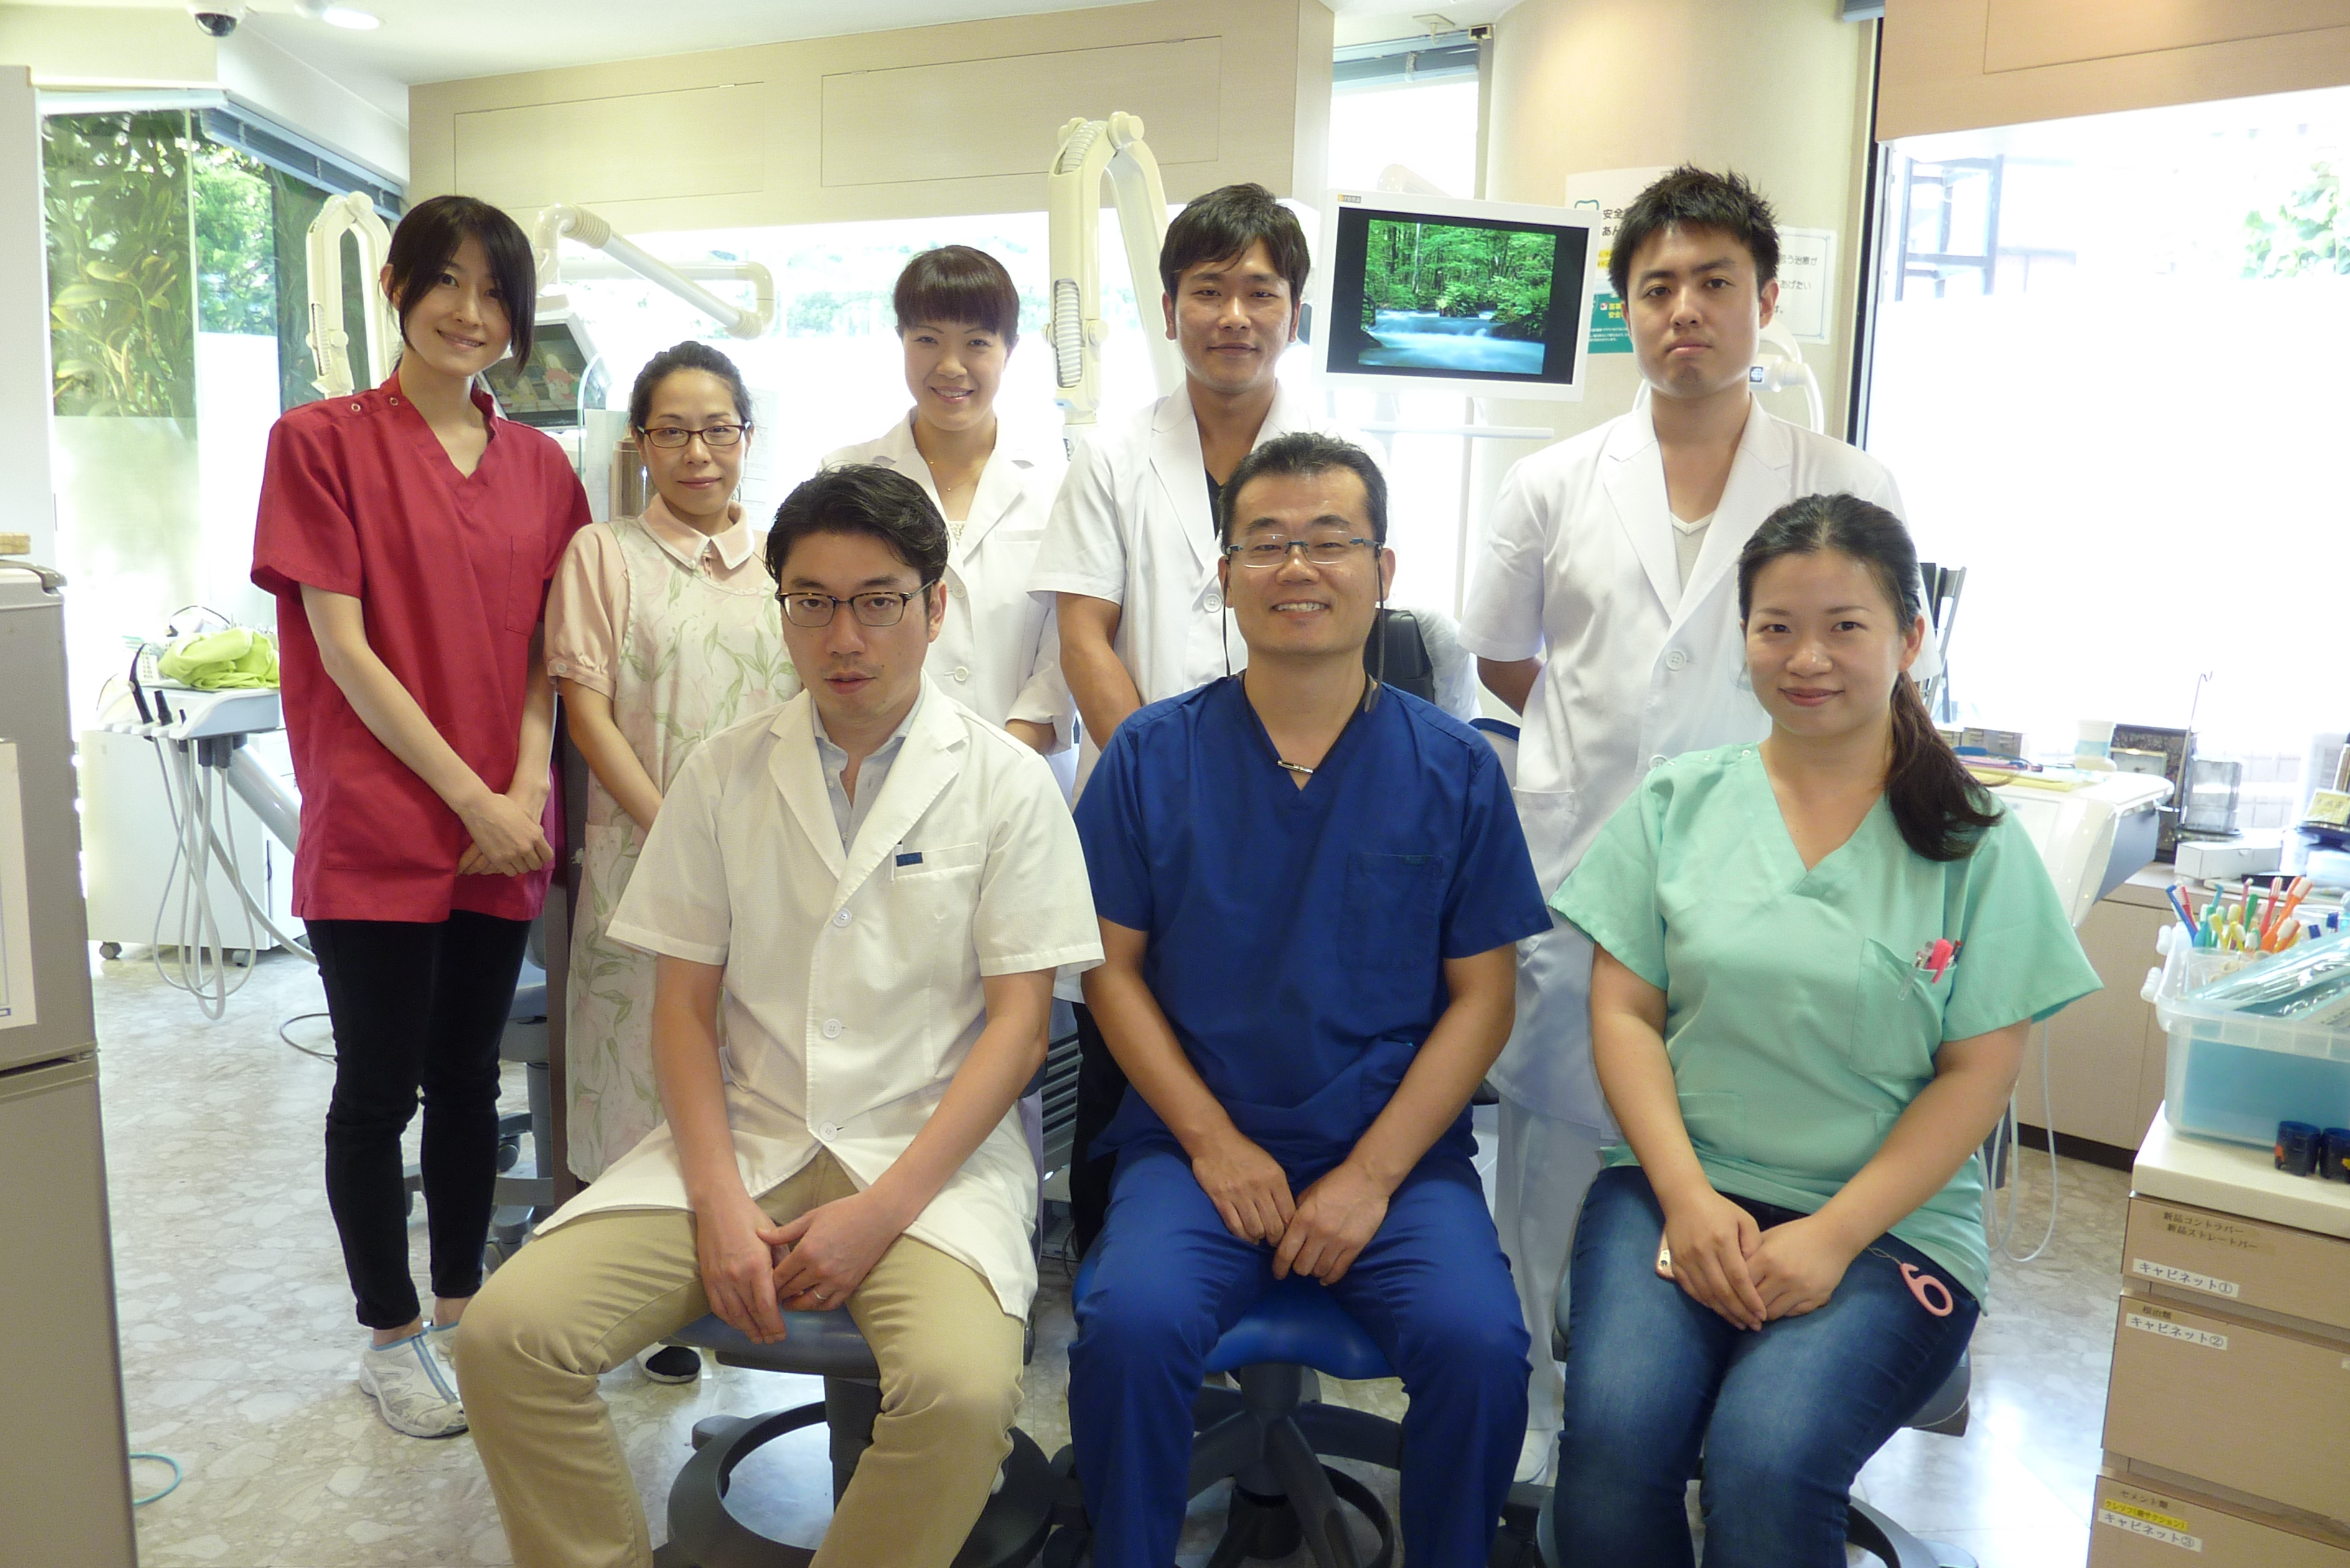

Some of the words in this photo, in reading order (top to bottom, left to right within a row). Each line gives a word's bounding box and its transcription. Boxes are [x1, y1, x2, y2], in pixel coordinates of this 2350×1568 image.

[2140, 1262, 2233, 1294] キャビネット①
[2130, 1316, 2224, 1348] キャビネット②
